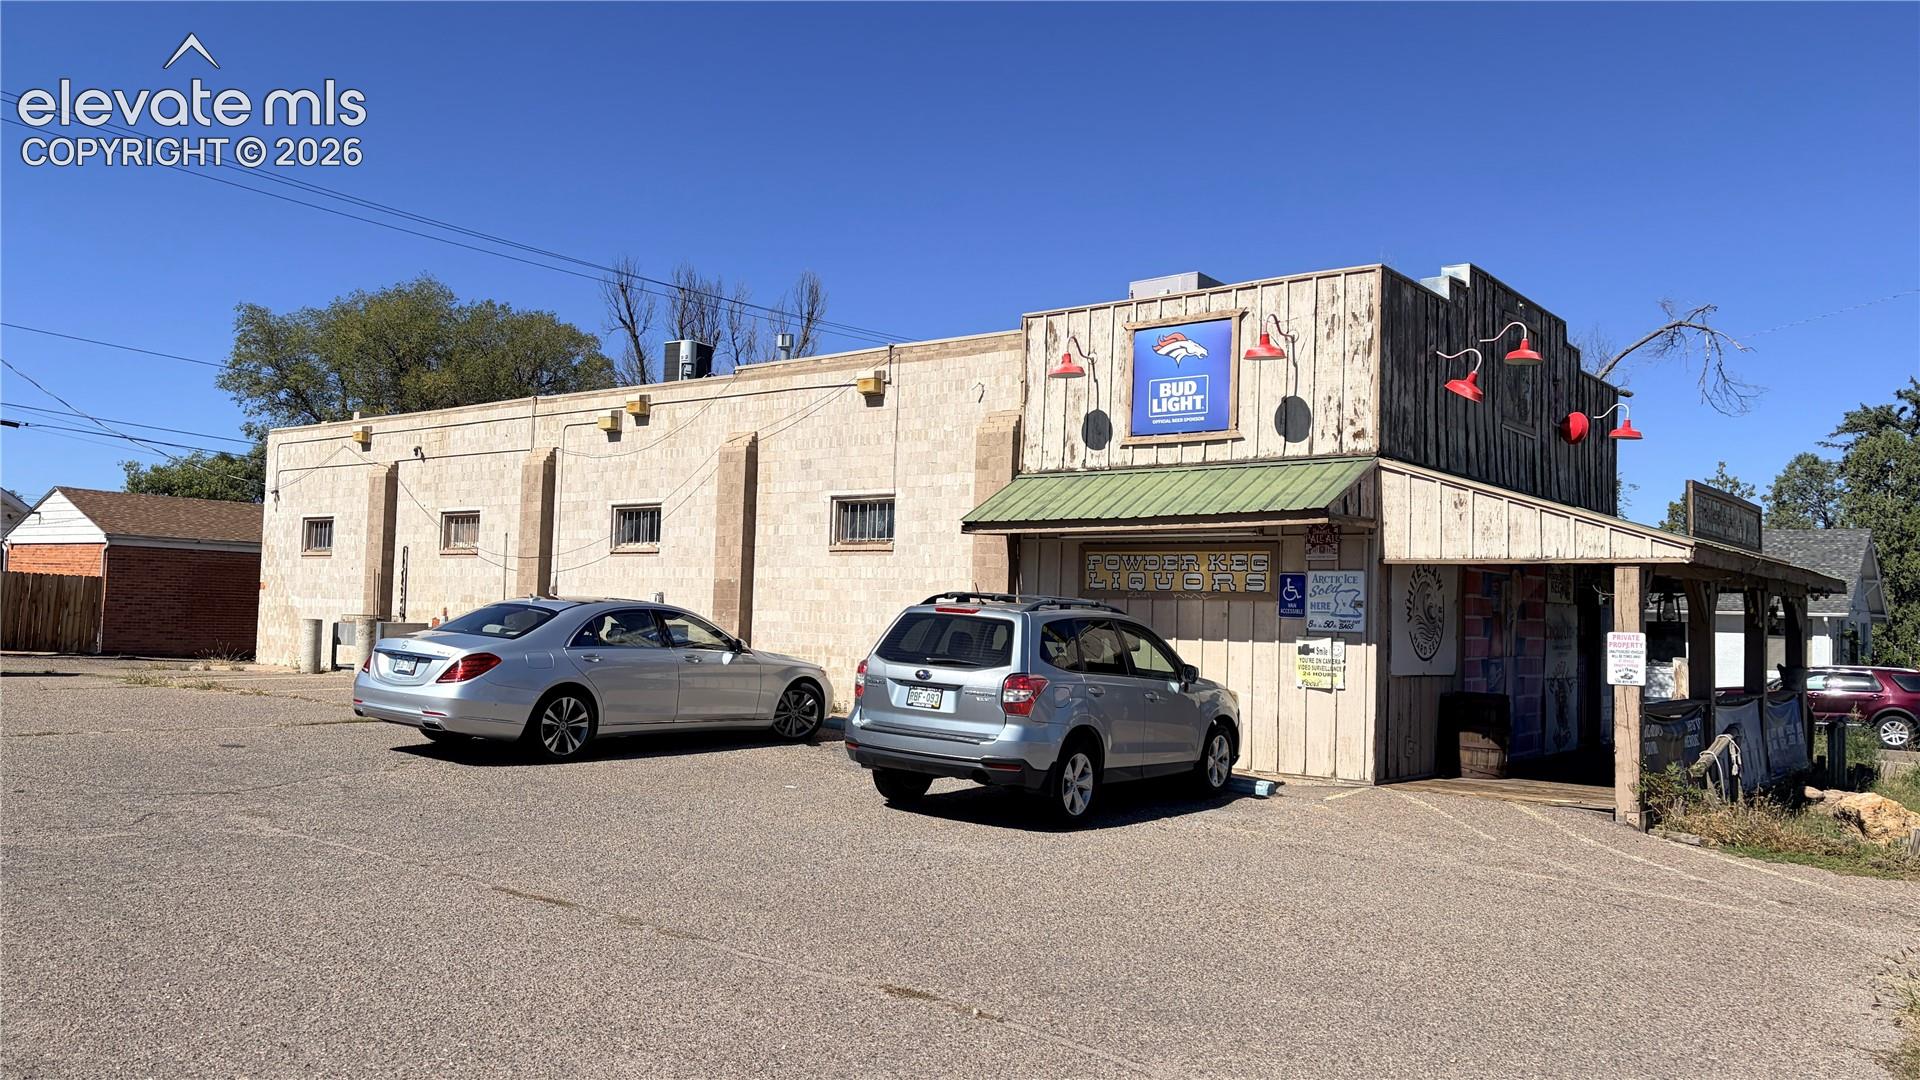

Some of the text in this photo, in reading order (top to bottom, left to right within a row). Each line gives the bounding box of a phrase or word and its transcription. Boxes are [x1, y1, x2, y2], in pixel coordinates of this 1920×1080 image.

[1159, 380, 1197, 398] BUD
[1152, 395, 1204, 413] LIGHT
[1087, 553, 1269, 572] POWDER KEG
[1089, 571, 1266, 592] LIQUORS
[1312, 573, 1359, 584] ARCTIC ICE
[1310, 583, 1343, 597] Sold
[1310, 602, 1331, 610] HERE
